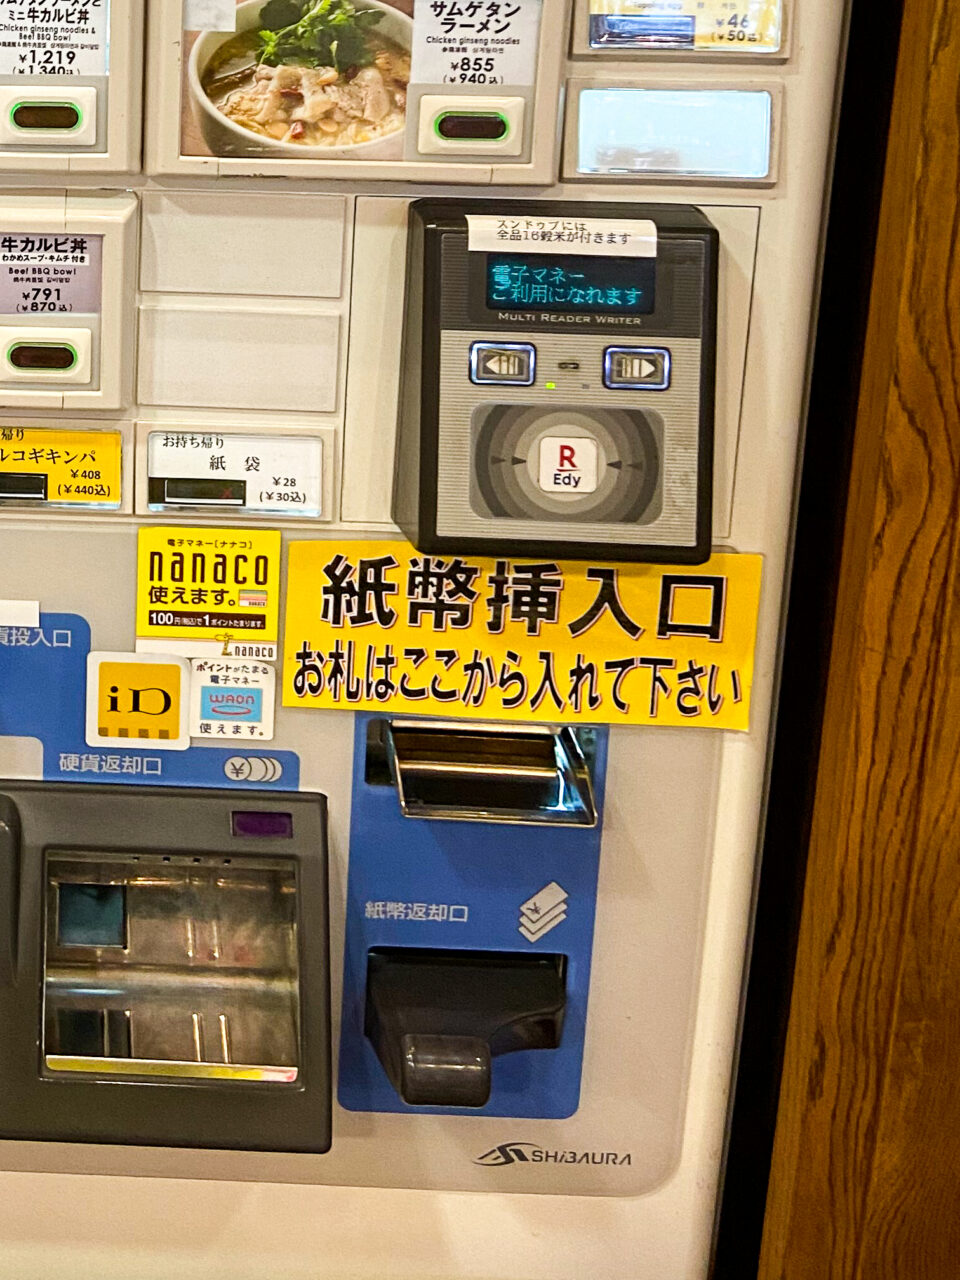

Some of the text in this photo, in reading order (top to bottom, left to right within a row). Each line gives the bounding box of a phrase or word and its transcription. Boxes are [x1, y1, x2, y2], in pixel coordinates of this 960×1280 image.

[9, 7, 89, 25] ミニ牛カルビ丼
[430, 0, 522, 18] サムゲタン
[60, 26, 89, 34] noodles
[440, 17, 511, 35] ラーメン
[426, 36, 520, 46] Chicken ginseng noodles
[19, 50, 76, 66] ¥1,219
[451, 57, 495, 72] ¥855
[497, 219, 587, 231] スンドゥブには
[497, 229, 632, 244] 全品16穀米が付きます
[1, 236, 88, 254] 牛カルビ丼
[8, 267, 77, 276] Beef BBQ bowl
[492, 265, 585, 285] 電子マネー
[22, 288, 61, 301] ¥791
[492, 283, 643, 305] ご利用になれます
[498, 312, 641, 325] MULTI READER WRITER
[559, 445, 576, 469] R
[70, 469, 101, 480] ¥408
[272, 477, 296, 488] ¥28
[553, 473, 581, 488] Edy
[149, 551, 268, 586] nanaco
[149, 585, 236, 607] 使えます。
[320, 553, 728, 643] 紙幣挿入口
[234, 646, 274, 658] nanaco
[210, 675, 260, 685] 電子マネー
[292, 639, 743, 718] お札はここから入れて下さい
[106, 685, 172, 716] iD
[200, 722, 264, 737] 使えます。
[59, 753, 162, 775] 硬貨返却口
[365, 901, 469, 923] 紙幣返却口
